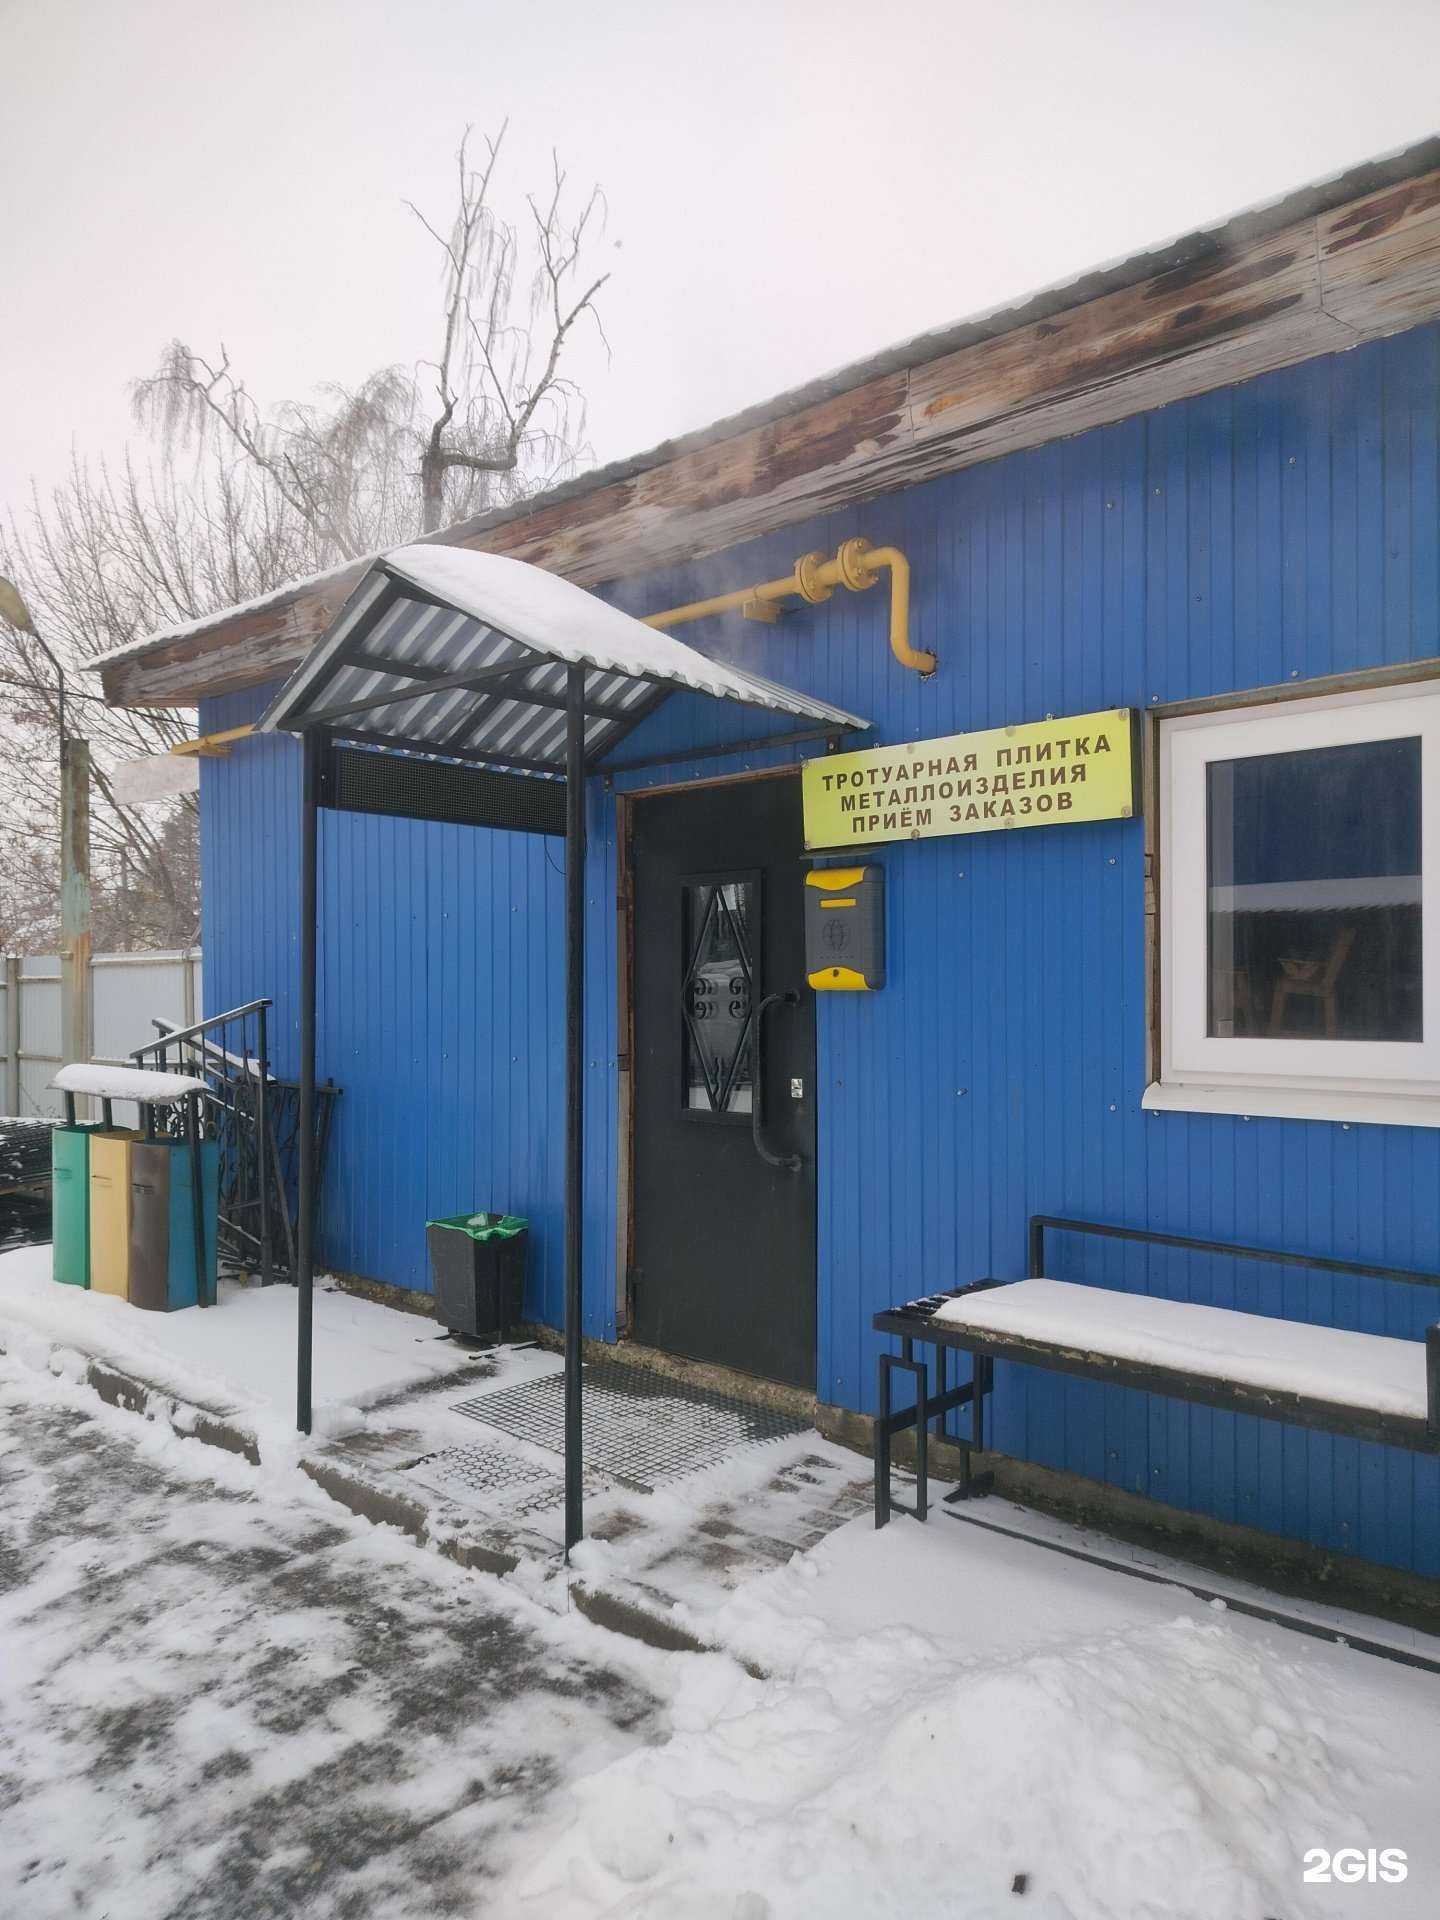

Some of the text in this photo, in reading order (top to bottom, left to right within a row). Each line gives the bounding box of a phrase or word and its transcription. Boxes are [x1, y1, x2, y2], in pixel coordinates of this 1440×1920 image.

[822, 734, 1112, 792] ТРОТУАРНАЯ ПЛИТКА
[840, 763, 1087, 812] МЕТАЛЛОИЗДЕЛИЯ
[852, 791, 1073, 833] ПРИЁМ ЗАКАЗОВ
